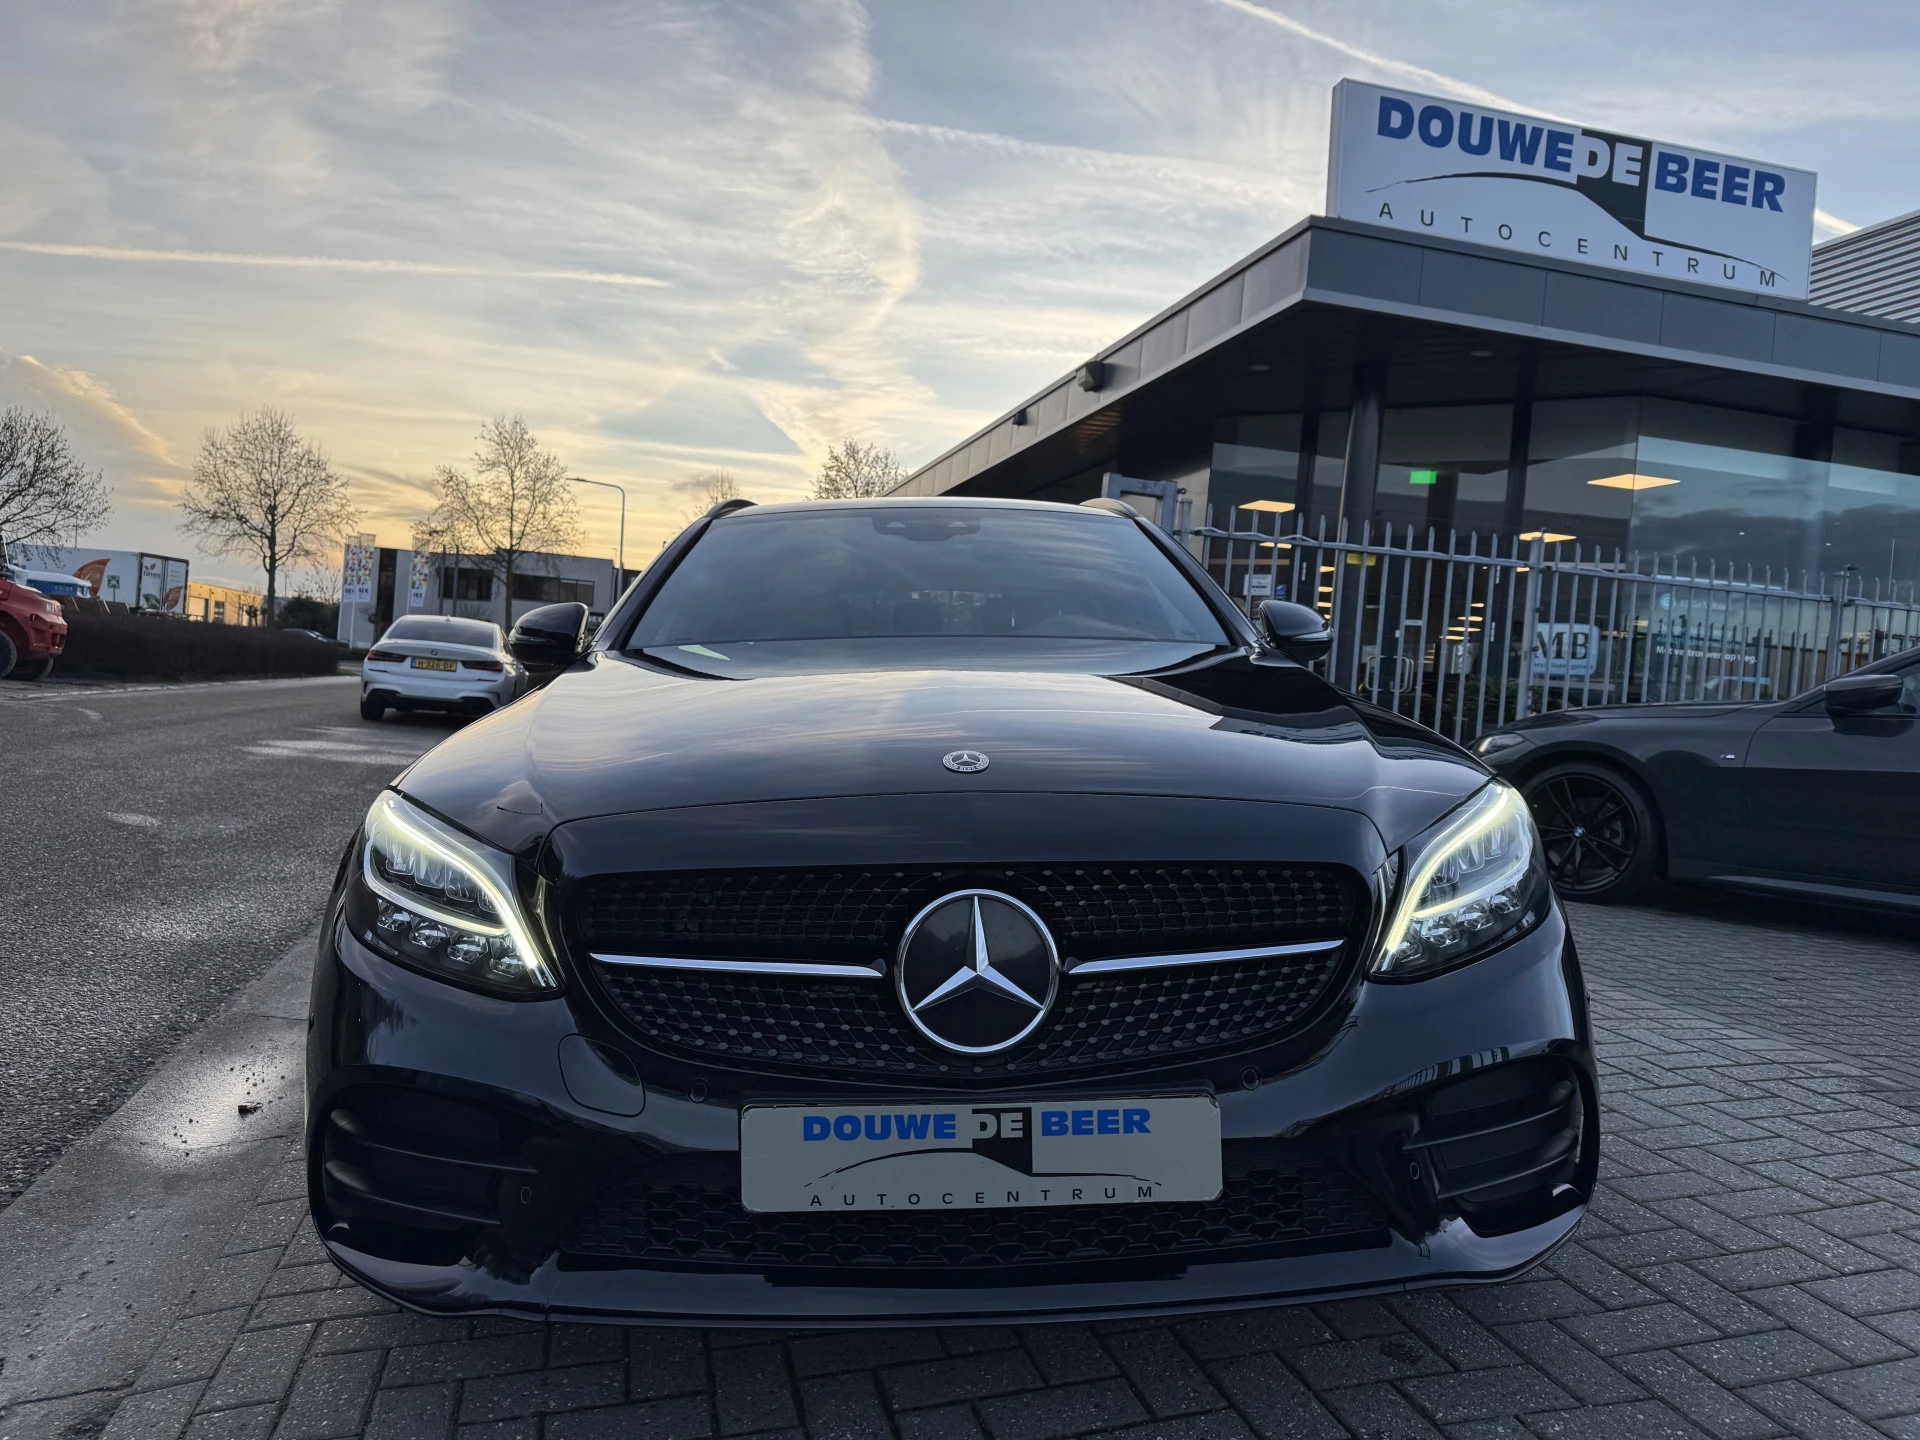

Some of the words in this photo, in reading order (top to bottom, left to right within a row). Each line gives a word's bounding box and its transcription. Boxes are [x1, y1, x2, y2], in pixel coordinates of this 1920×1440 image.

[1377, 96, 1575, 173] DOUWE
[1577, 134, 1644, 187] DE
[1655, 151, 1786, 213] BEER
[1379, 203, 1776, 288] AUTOCENTRUM
[1534, 631, 1591, 660] MB
[1656, 646, 1673, 655] Mt
[803, 1114, 956, 1142] DOUWE
[971, 1112, 1024, 1140] DE
[1041, 1108, 1152, 1137] BEER
[810, 1186, 1153, 1207] AUTOCENTRUM
